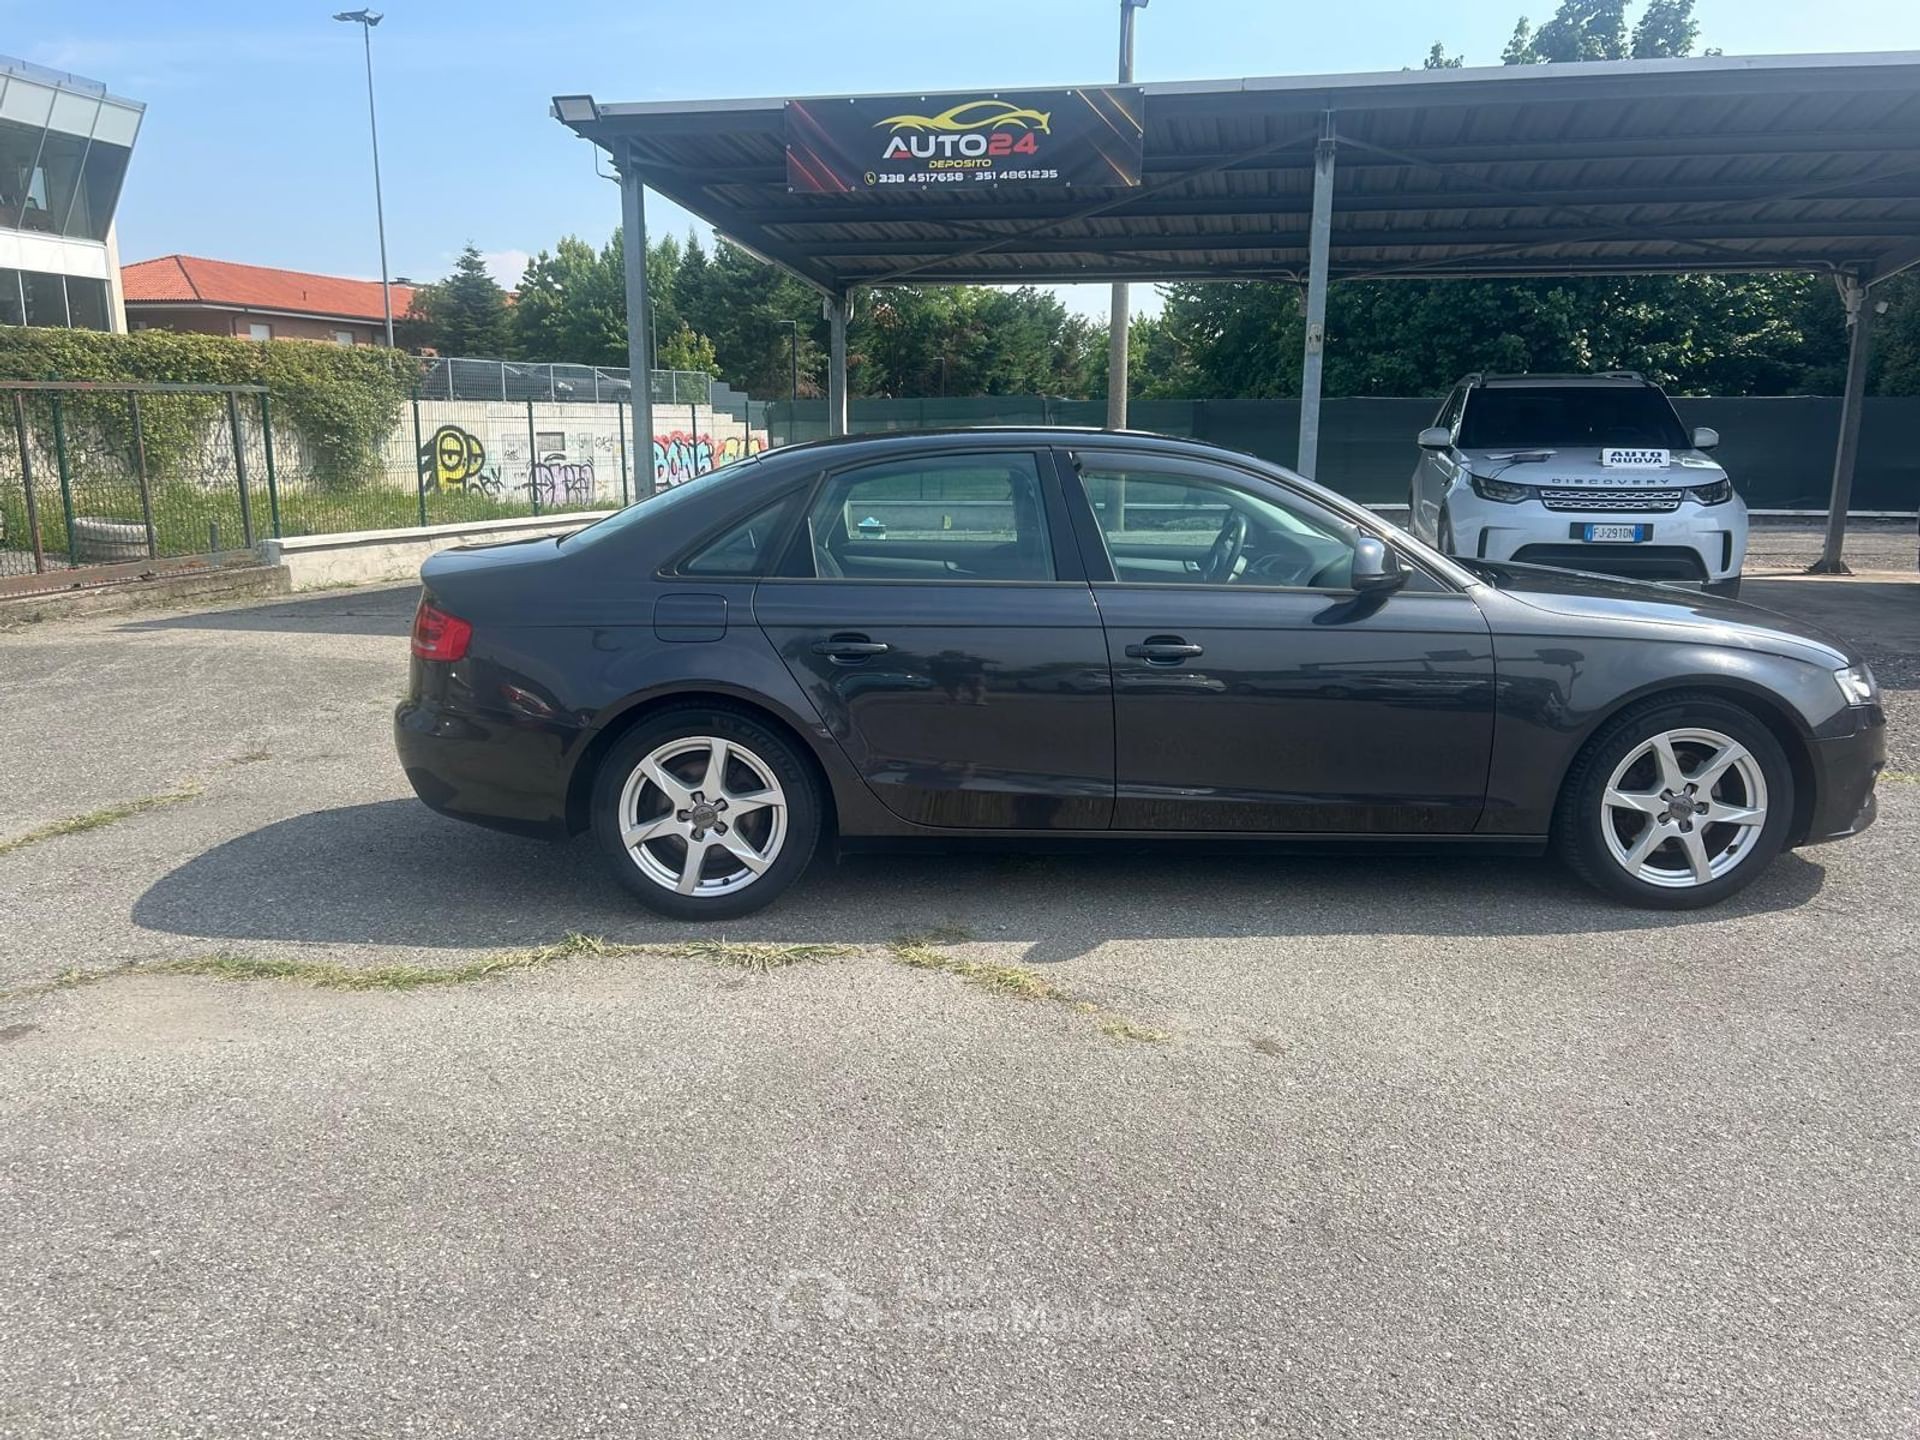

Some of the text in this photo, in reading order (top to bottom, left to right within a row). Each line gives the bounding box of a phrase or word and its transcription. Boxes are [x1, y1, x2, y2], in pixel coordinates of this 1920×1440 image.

[882, 132, 1038, 159] AUTO24
[928, 159, 992, 169] DEPOSITO
[879, 173, 905, 183] 338
[908, 172, 964, 183] 4517658
[975, 171, 997, 181] 351
[999, 170, 1058, 180] 4861235
